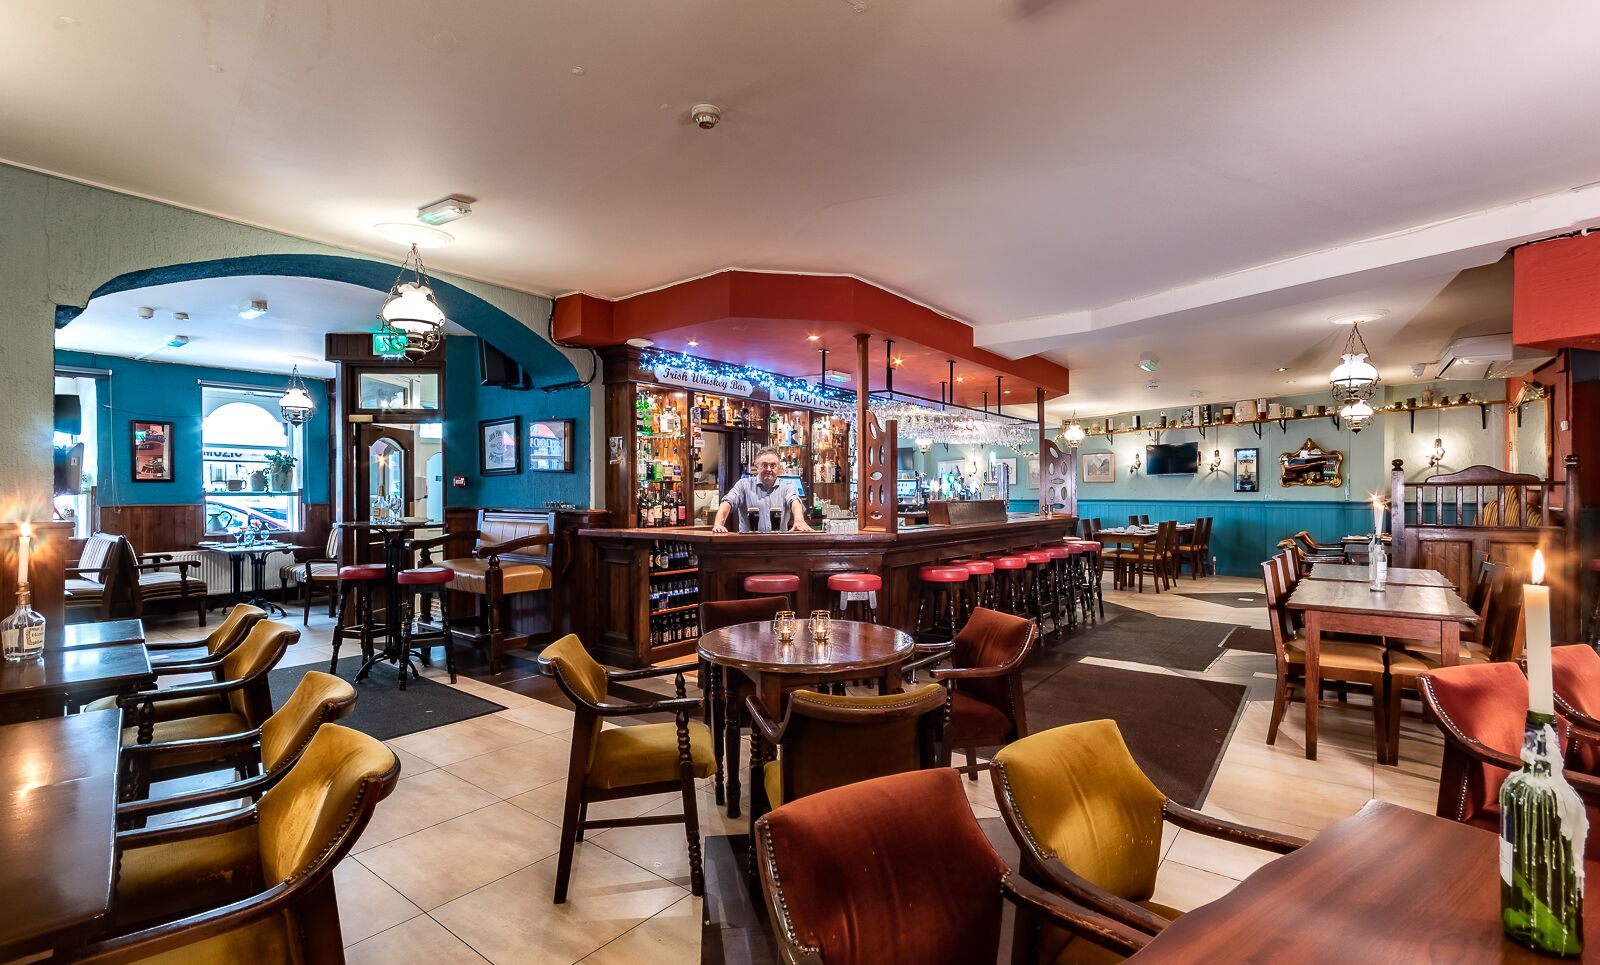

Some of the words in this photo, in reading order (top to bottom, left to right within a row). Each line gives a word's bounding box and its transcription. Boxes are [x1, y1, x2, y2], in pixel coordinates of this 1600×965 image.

[663, 368, 688, 382] Irish
[691, 373, 728, 390] Whiskey
[730, 380, 747, 391] Bar
